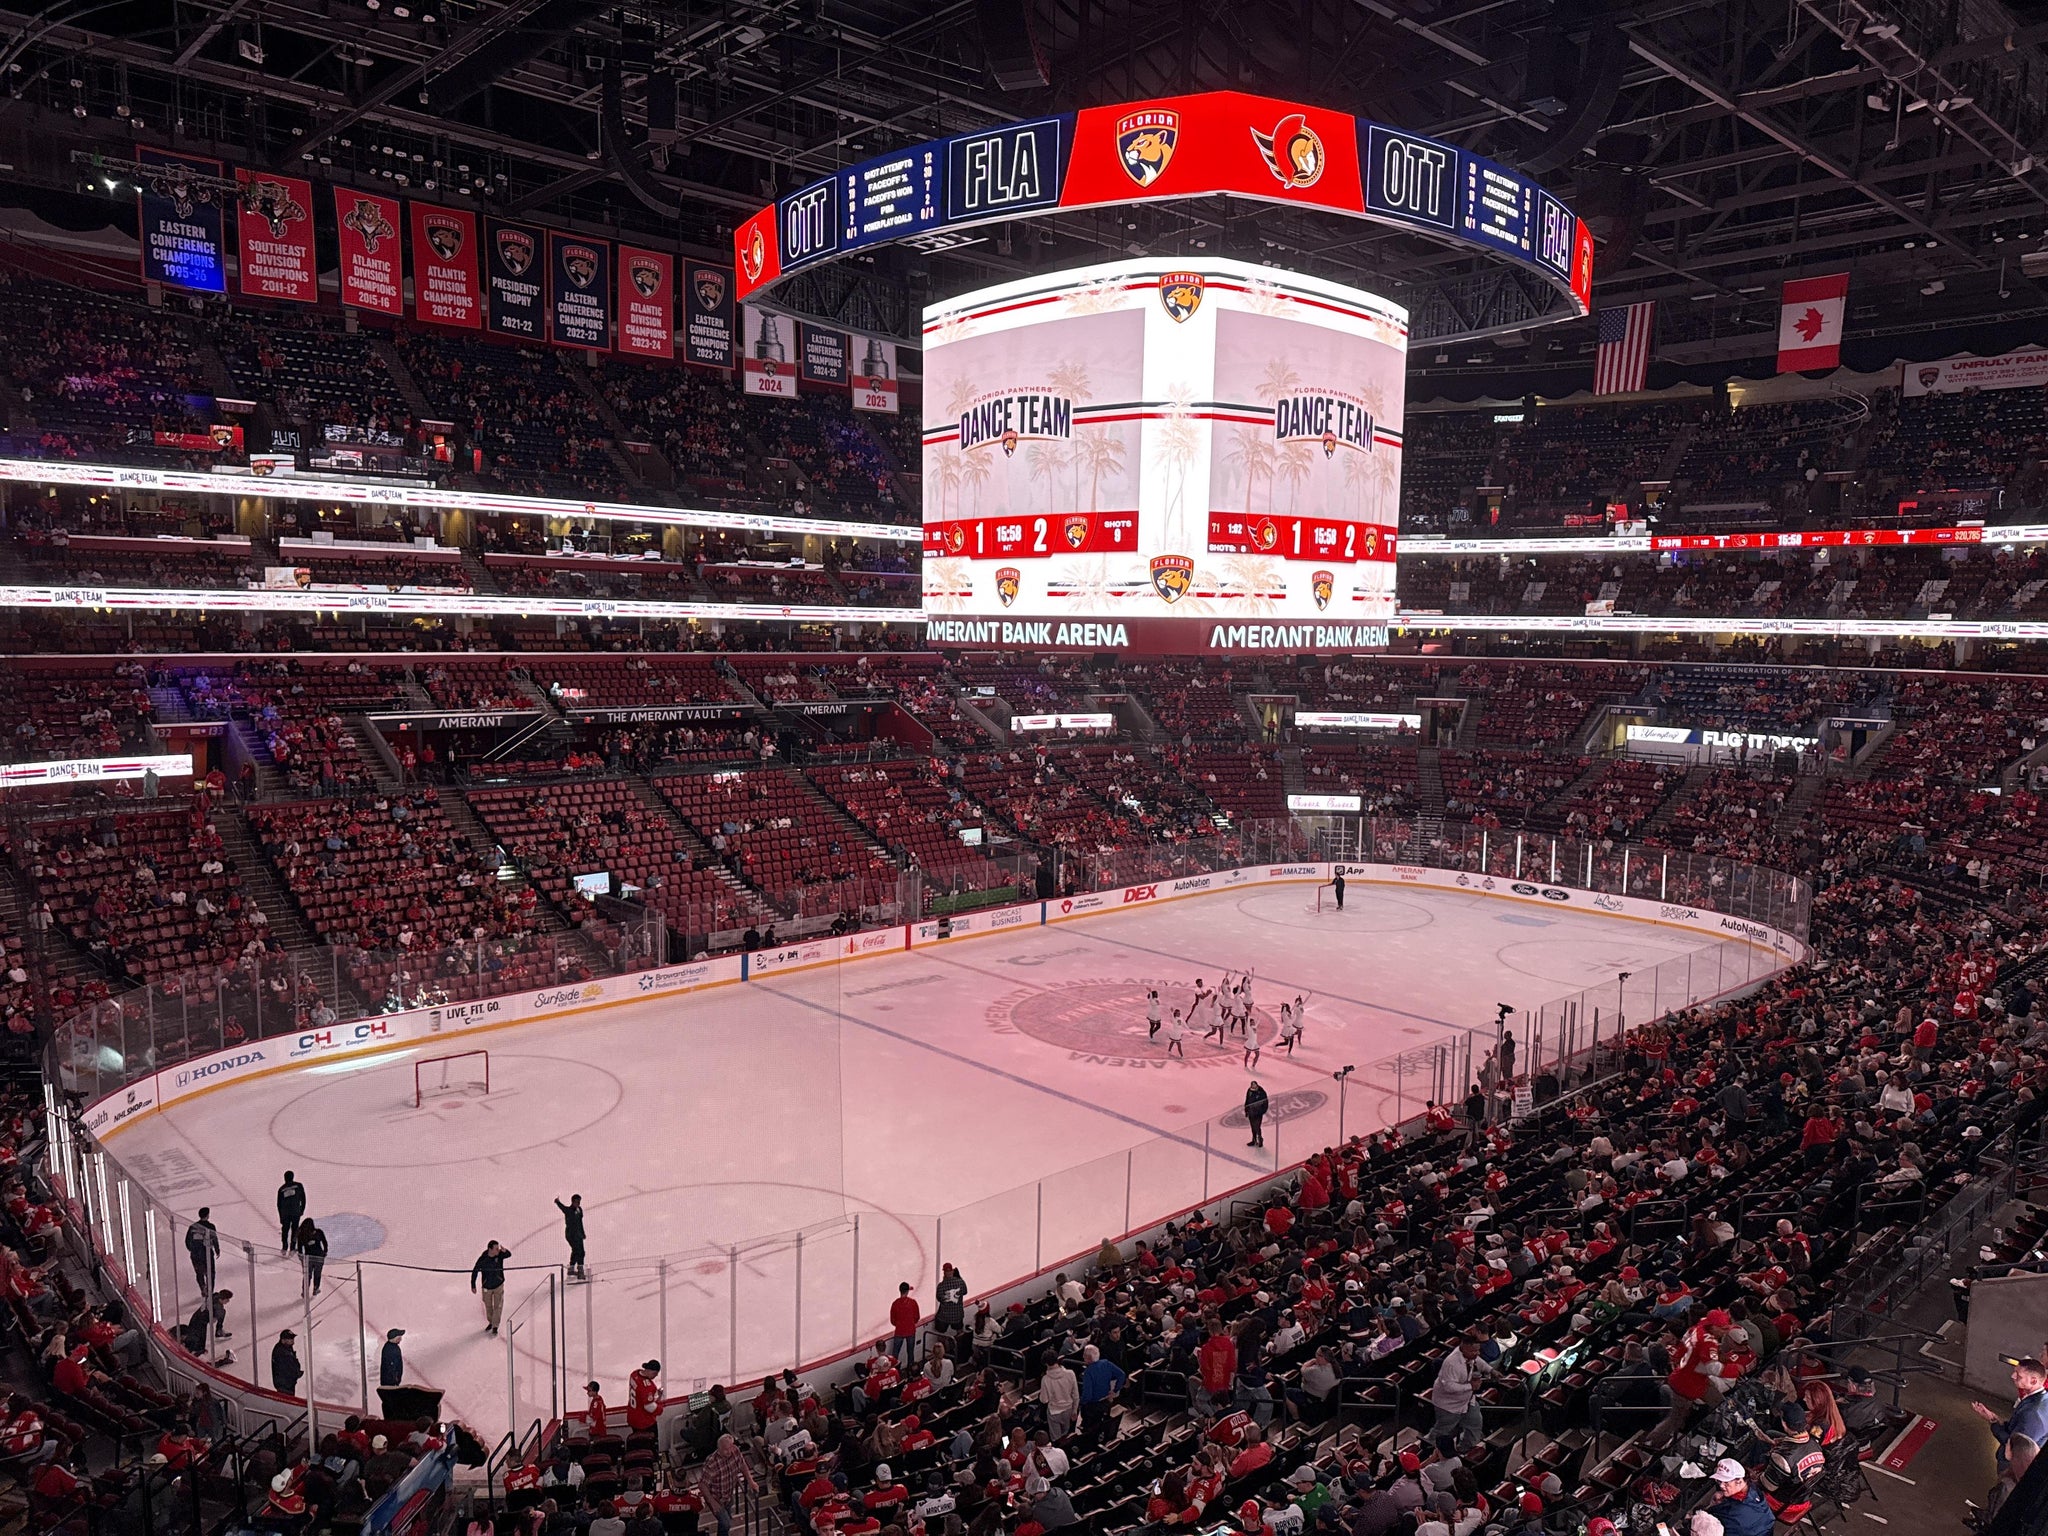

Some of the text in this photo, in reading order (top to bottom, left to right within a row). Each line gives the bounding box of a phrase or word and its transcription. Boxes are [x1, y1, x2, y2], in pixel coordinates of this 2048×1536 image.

[1122, 114, 1173, 132] FLORIDA
[880, 159, 913, 175] ATTEMPTS
[966, 132, 1040, 209] FLA
[868, 176, 900, 192] FACEOFF
[1384, 139, 1445, 216] OTT
[925, 180, 930, 191] 7
[864, 186, 913, 206] FACEOFFS WON
[925, 194, 930, 205] 2
[1469, 203, 1473, 215] 2
[160, 220, 206, 239] EASTERN
[788, 188, 826, 258] OTT
[151, 233, 216, 255] CONFERENCE
[1543, 201, 1568, 272] FLA
[248, 240, 306, 257] SOUTHEAST
[153, 248, 214, 268] CHAMPIONS
[256, 253, 300, 269] DIVISION
[352, 254, 390, 272] ATLANTIC
[163, 264, 207, 281] 1995-96
[249, 264, 309, 282] CHAMPIONS
[354, 266, 389, 282] DIVISION
[428, 265, 466, 280] ATLANTIC
[1164, 274, 1200, 285] FLORIDA
[262, 280, 297, 295] 2011-12
[348, 276, 396, 296] CHAMPIONS
[429, 279, 466, 294] DIVISION
[492, 277, 540, 296] PRESIDENTS'
[359, 292, 390, 308] 2015-16
[423, 290, 473, 308] CHAMPIONS
[502, 291, 531, 307] TROPHY
[565, 292, 597, 306] EASTERN
[432, 305, 466, 319] 2021-22
[558, 302, 604, 319] CONFERENCE
[630, 302, 662, 316] ATLANTIC
[502, 316, 532, 332] 2021-22
[559, 314, 603, 330] CHAMPIONS
[631, 314, 661, 327] DIVISION
[696, 314, 724, 328] EASTERN
[567, 327, 597, 341] 2022-23
[626, 325, 667, 339] CHAMPIONS
[690, 324, 729, 340] CONFERENCE
[632, 337, 660, 350] 2023-24
[690, 336, 728, 350] CHAMPIONS
[812, 334, 837, 347] EASTERN
[697, 348, 723, 360] 2023-24
[807, 344, 842, 357] CONFERENCE
[808, 354, 841, 368] CHAMPIONS
[1952, 358, 2014, 370] UNRULY
[813, 366, 837, 378] 2024-25
[759, 378, 782, 392] 2024
[866, 394, 886, 407] 2025
[974, 390, 1004, 402] FLORIDA
[1329, 388, 1364, 405] PANTHERS
[961, 396, 1070, 450] DANCE TEAM
[1277, 397, 1374, 452] DANCE TEAM
[120, 474, 157, 483] DANCE TEAM
[976, 522, 983, 553] 1
[997, 525, 1022, 542] 15:58
[1034, 518, 1047, 552] 2
[1292, 521, 1301, 554] 1
[1314, 528, 1336, 545] 15:58
[1344, 525, 1355, 557] 2
[1760, 535, 1764, 545] 1
[1844, 533, 1850, 544] 2
[1154, 559, 1190, 568] FLORIDA
[55, 591, 102, 602] DANCE TEAM
[350, 598, 387, 608] DANCE TEAM
[926, 621, 1128, 646] AMERANT BANK ARENA
[1762, 622, 1779, 630] DANCE
[1983, 625, 2016, 634] DANCE TEAM
[1210, 625, 1389, 648] AMERANT BANK ARENA
[608, 709, 722, 722] THE AMERANT VAULT
[804, 705, 847, 714] AMERANT
[439, 716, 503, 728] AMERANT
[208, 727, 223, 736] 133
[50, 763, 100, 777] DANCE TEAM
[1174, 878, 1210, 891] AutoNation
[1517, 885, 1534, 894] Ford
[1124, 885, 1158, 903] DEX
[1546, 890, 1565, 900] Ford
[992, 908, 1022, 919] COMCAST
[1661, 905, 1688, 915] OMEGA
[1661, 910, 1699, 920] SPORT XL
[992, 916, 1022, 927] BUSINESS
[1721, 917, 1768, 939] AutoNation
[534, 988, 579, 1008] Surfside
[447, 1001, 501, 1019] LIVE. FIT. GO.
[355, 1021, 386, 1038] CH
[299, 1031, 332, 1049] CH
[290, 1049, 311, 1057] Cooper
[192, 1051, 265, 1080] HONDA
[1923, 1420, 1936, 1430] 120
[1891, 1458, 1903, 1468] 121
[926, 1501, 953, 1516] MARCHAND
[1275, 1517, 1298, 1530] BARKOV
